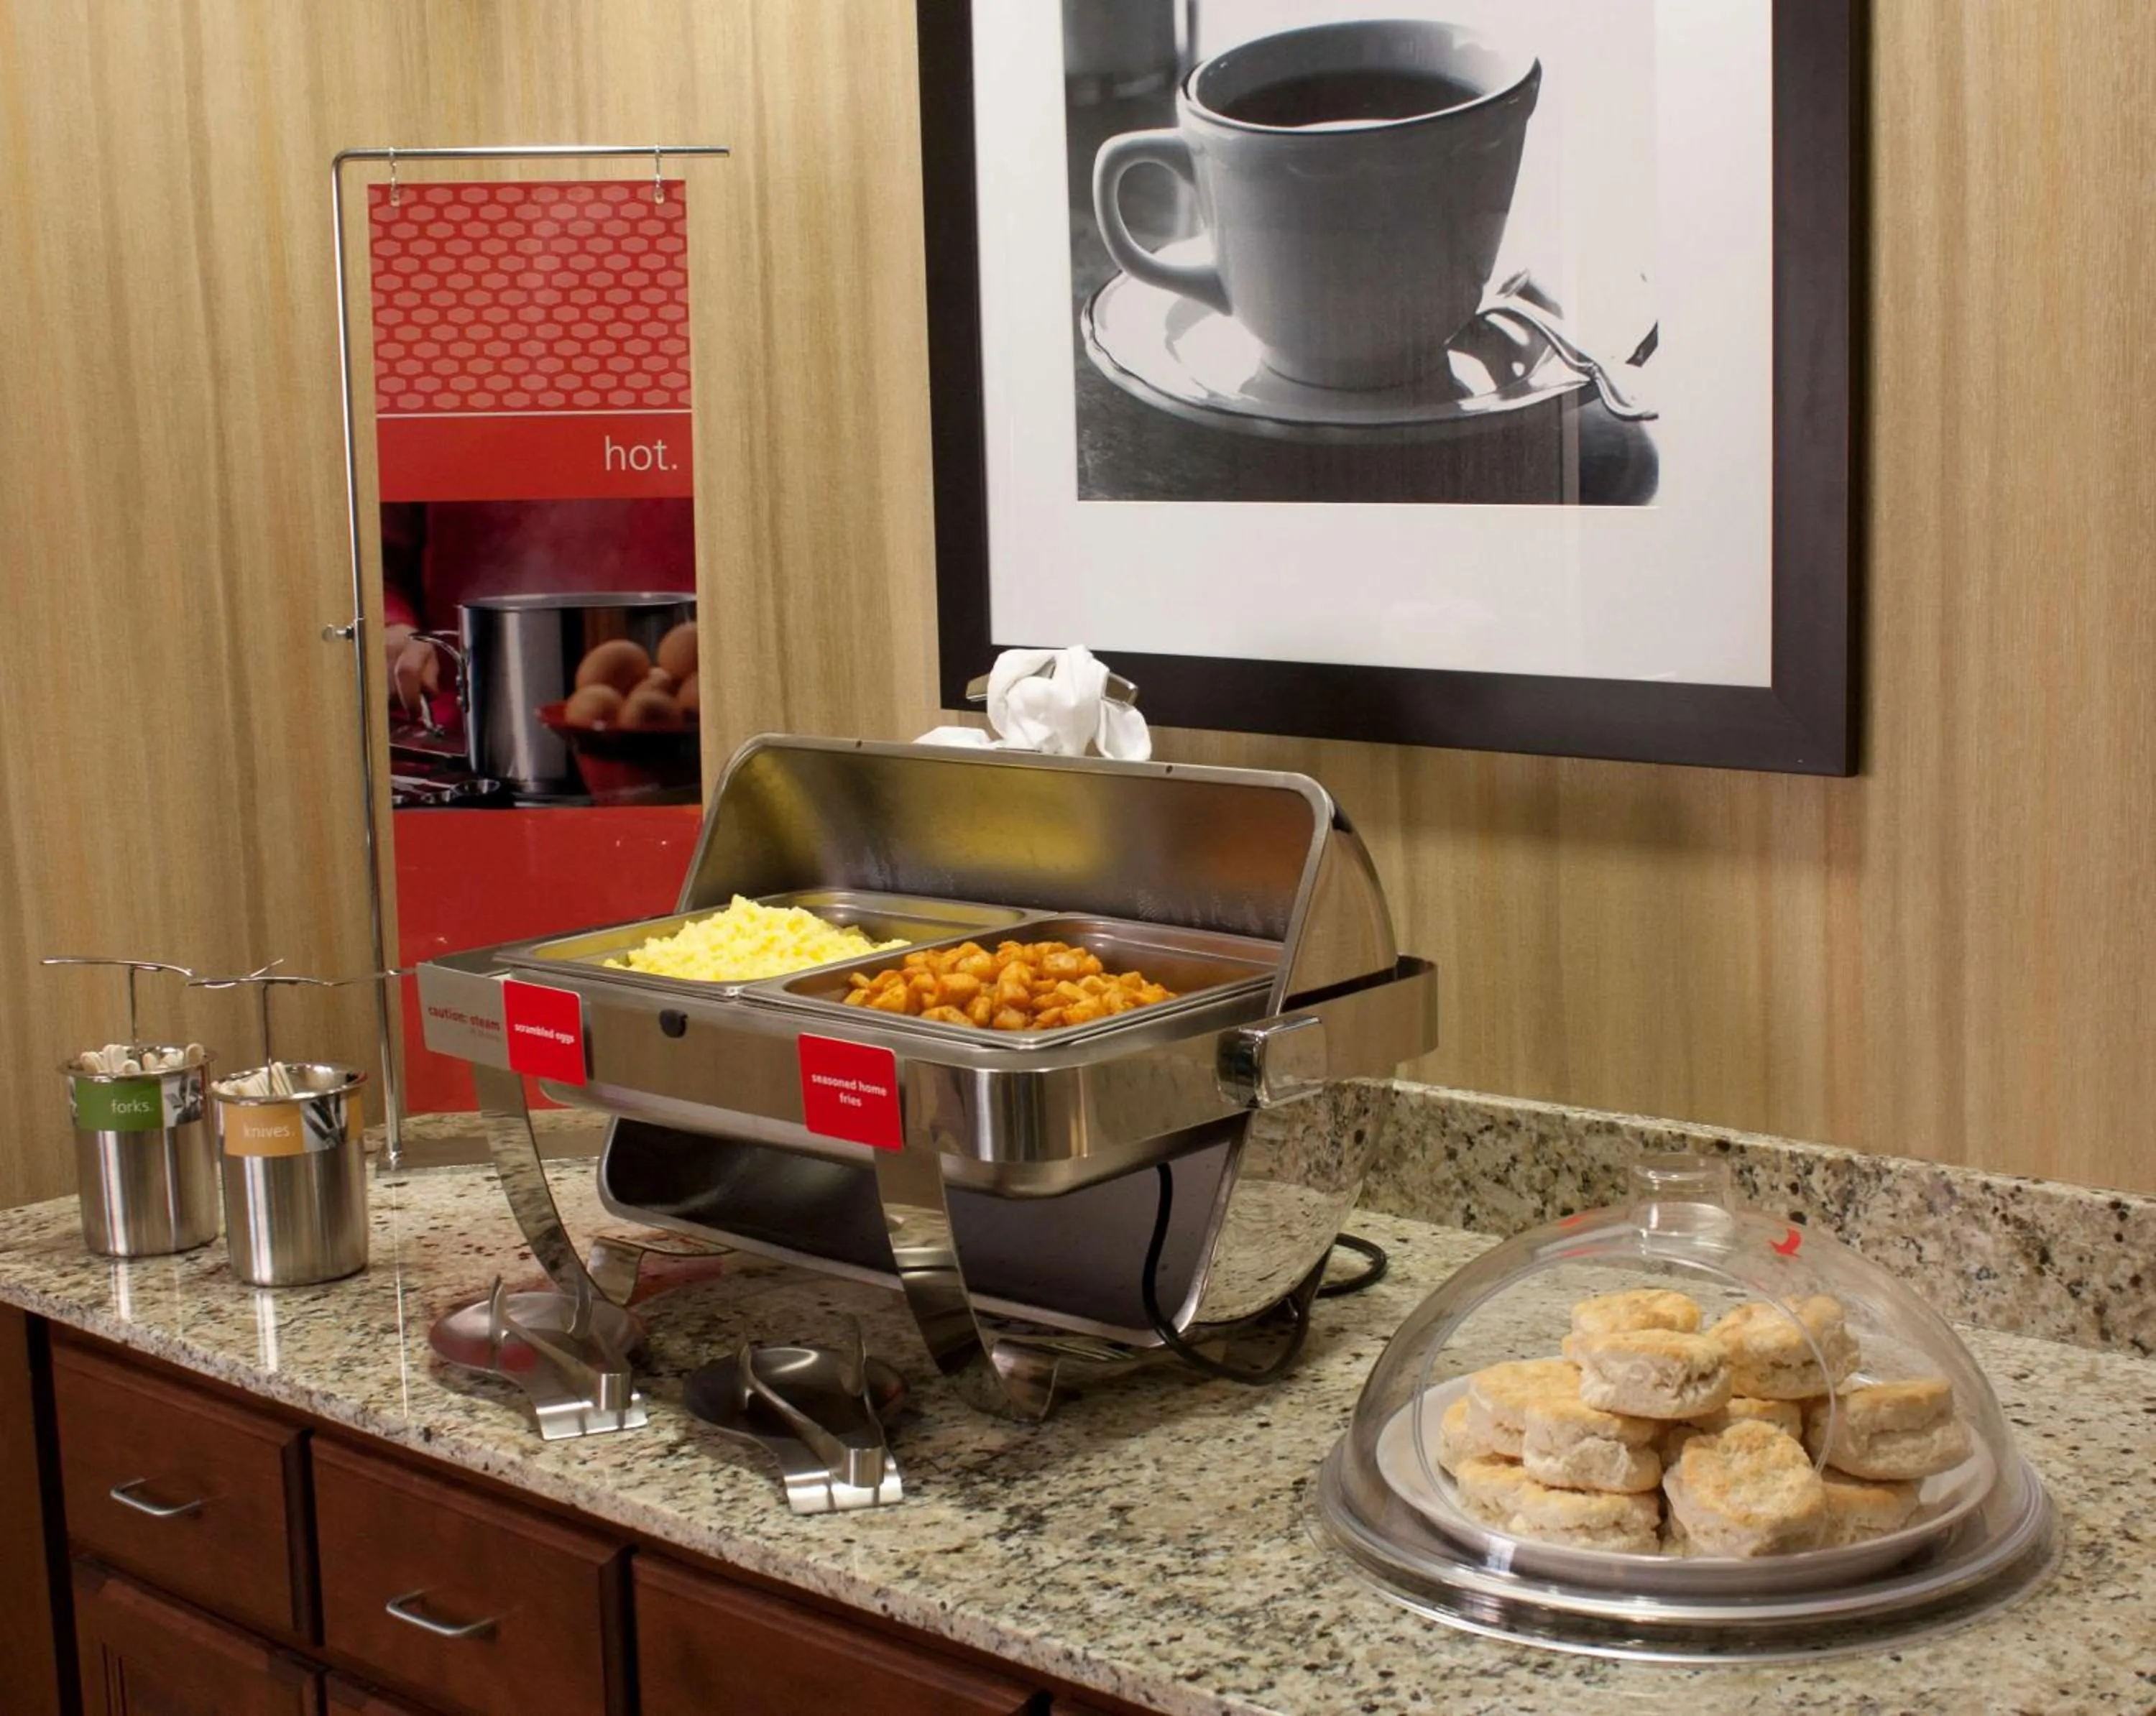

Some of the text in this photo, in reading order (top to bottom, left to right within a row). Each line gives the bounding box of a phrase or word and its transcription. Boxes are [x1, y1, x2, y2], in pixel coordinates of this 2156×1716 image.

[604, 435, 678, 471] hot.
[469, 1015, 500, 1031] steam
[514, 1023, 555, 1039] scrambled
[556, 1032, 575, 1045] eggs
[811, 1074, 888, 1097] seasoned home
[839, 1092, 862, 1107] fries
